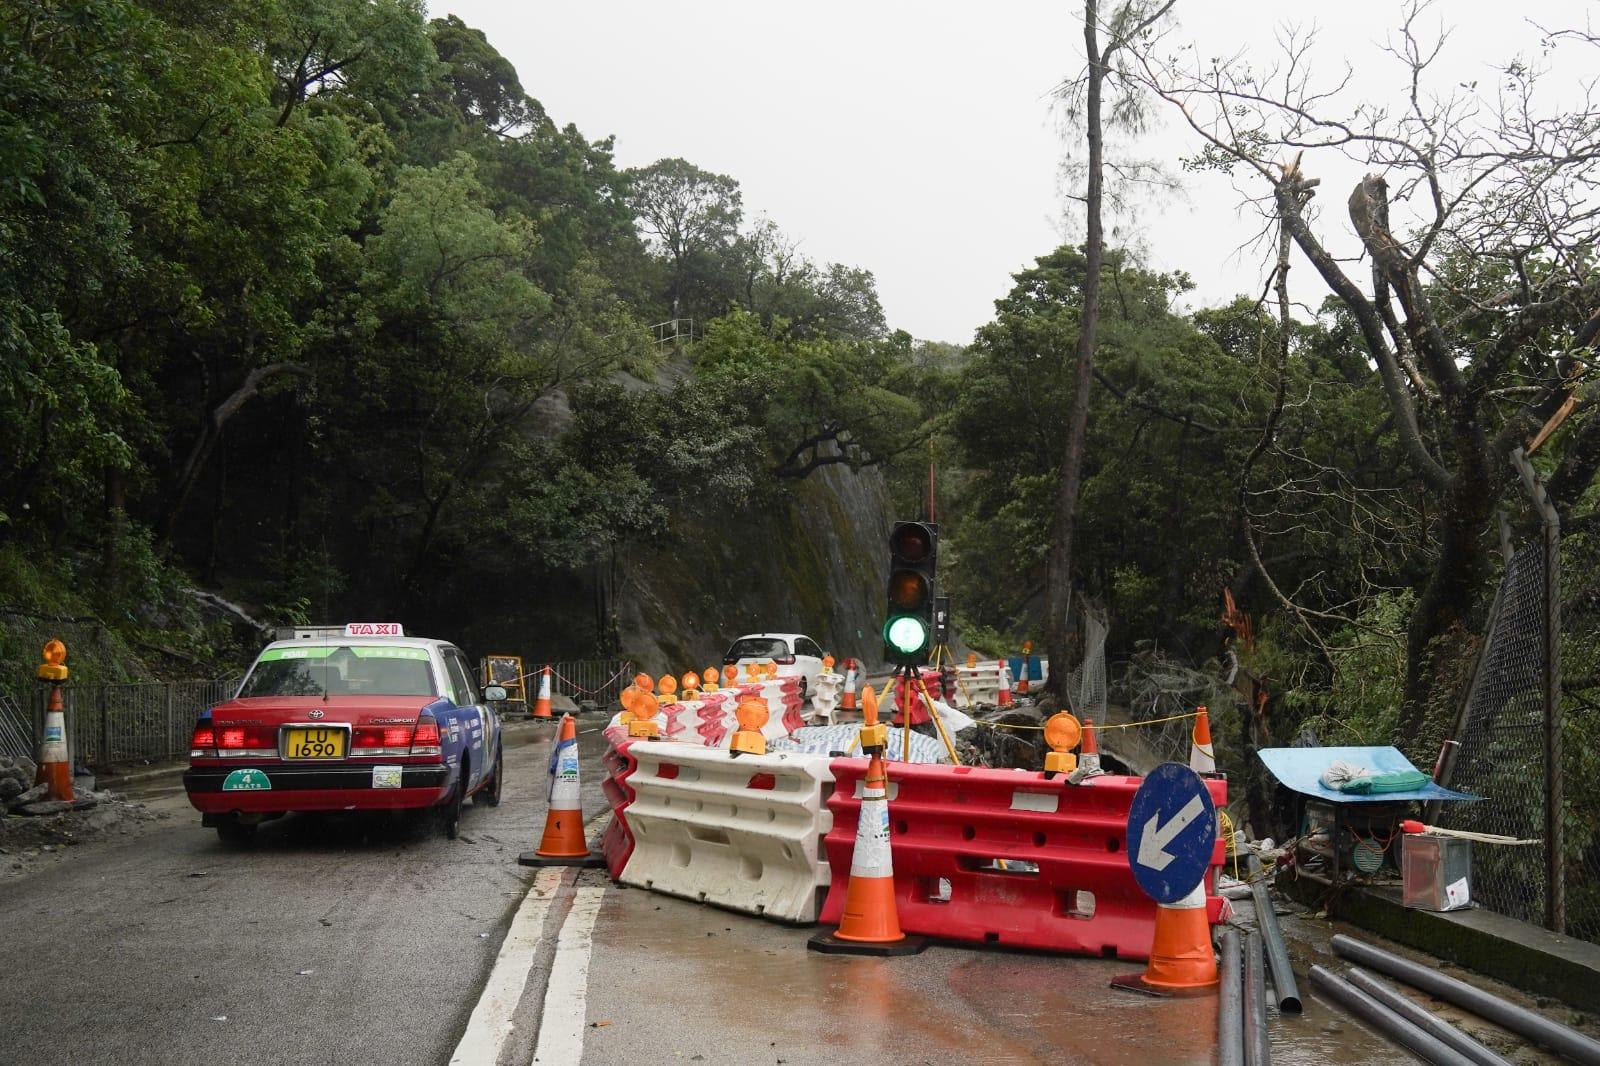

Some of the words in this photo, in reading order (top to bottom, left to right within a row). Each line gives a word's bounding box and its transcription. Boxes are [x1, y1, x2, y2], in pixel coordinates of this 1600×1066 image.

[349, 624, 399, 634] TAXI
[305, 731, 328, 743] LU
[295, 743, 335, 757] 1690
[242, 774, 252, 784] 4
